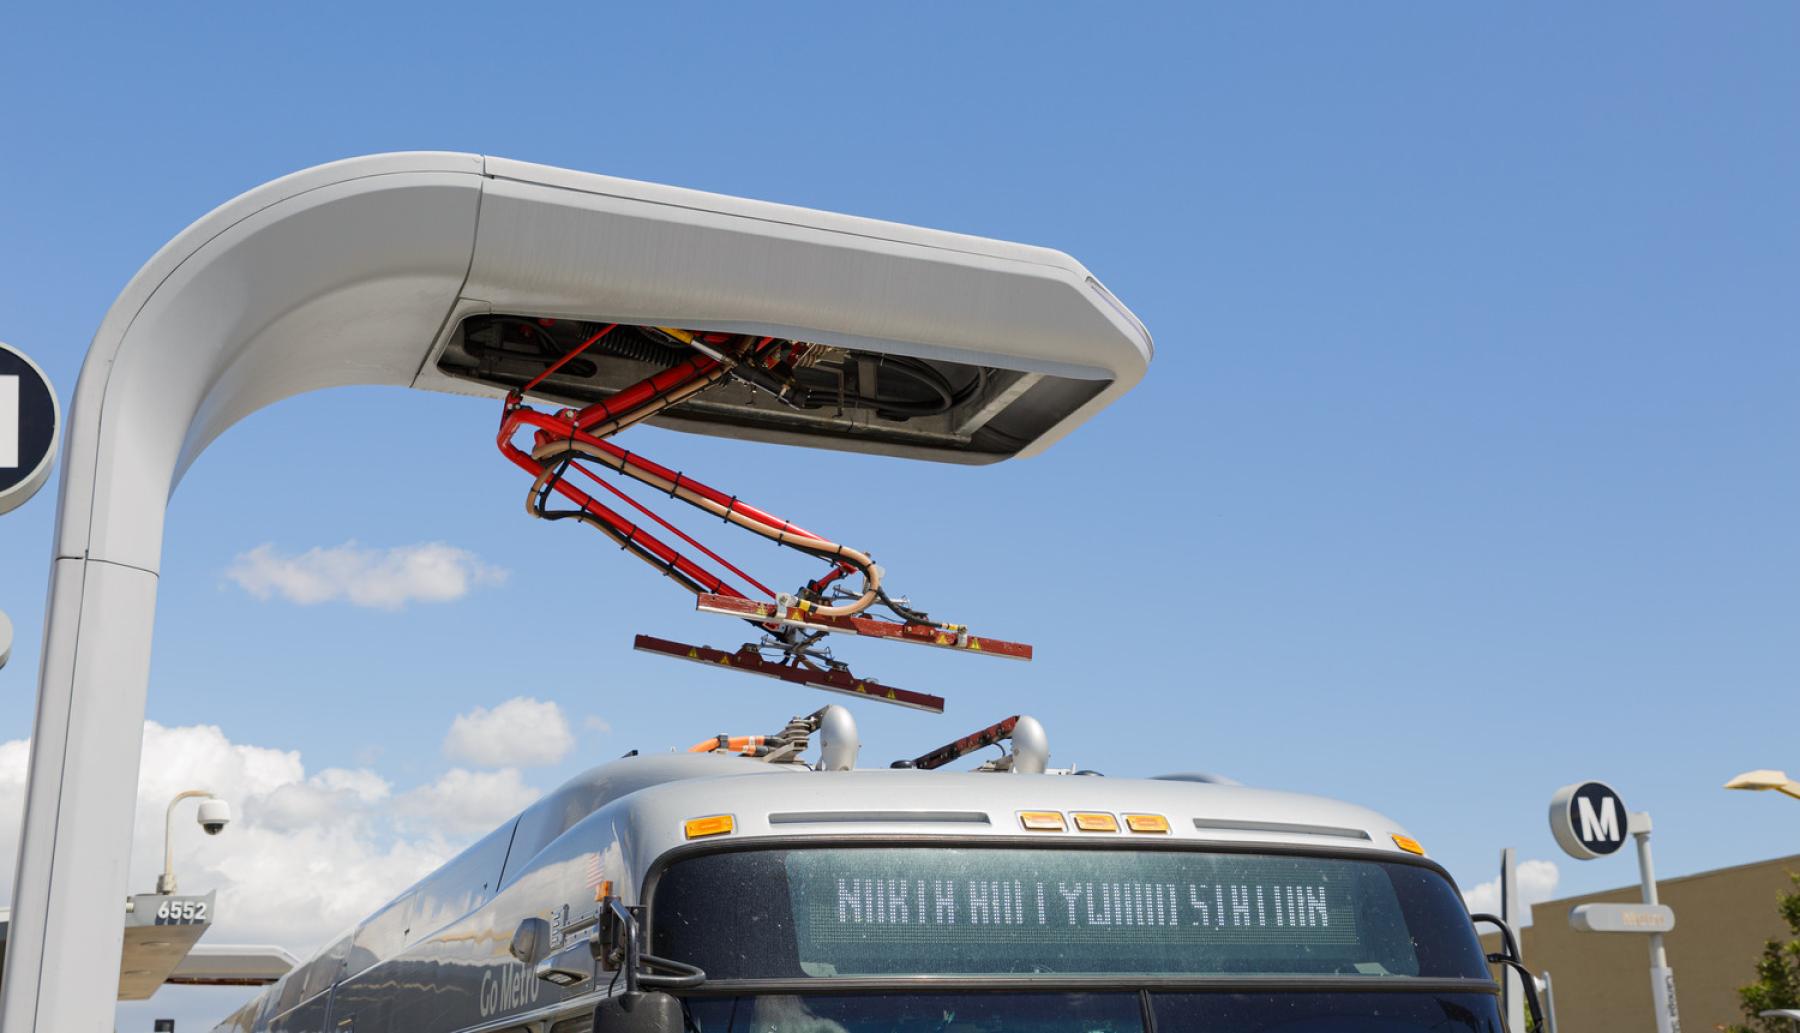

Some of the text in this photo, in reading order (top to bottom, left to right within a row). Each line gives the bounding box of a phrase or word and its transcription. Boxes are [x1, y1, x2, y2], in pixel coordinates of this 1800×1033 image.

[1577, 796, 1620, 842] M
[157, 900, 207, 921] 6552
[1622, 909, 1667, 927] Metro
[480, 961, 540, 1017] Go Metro
